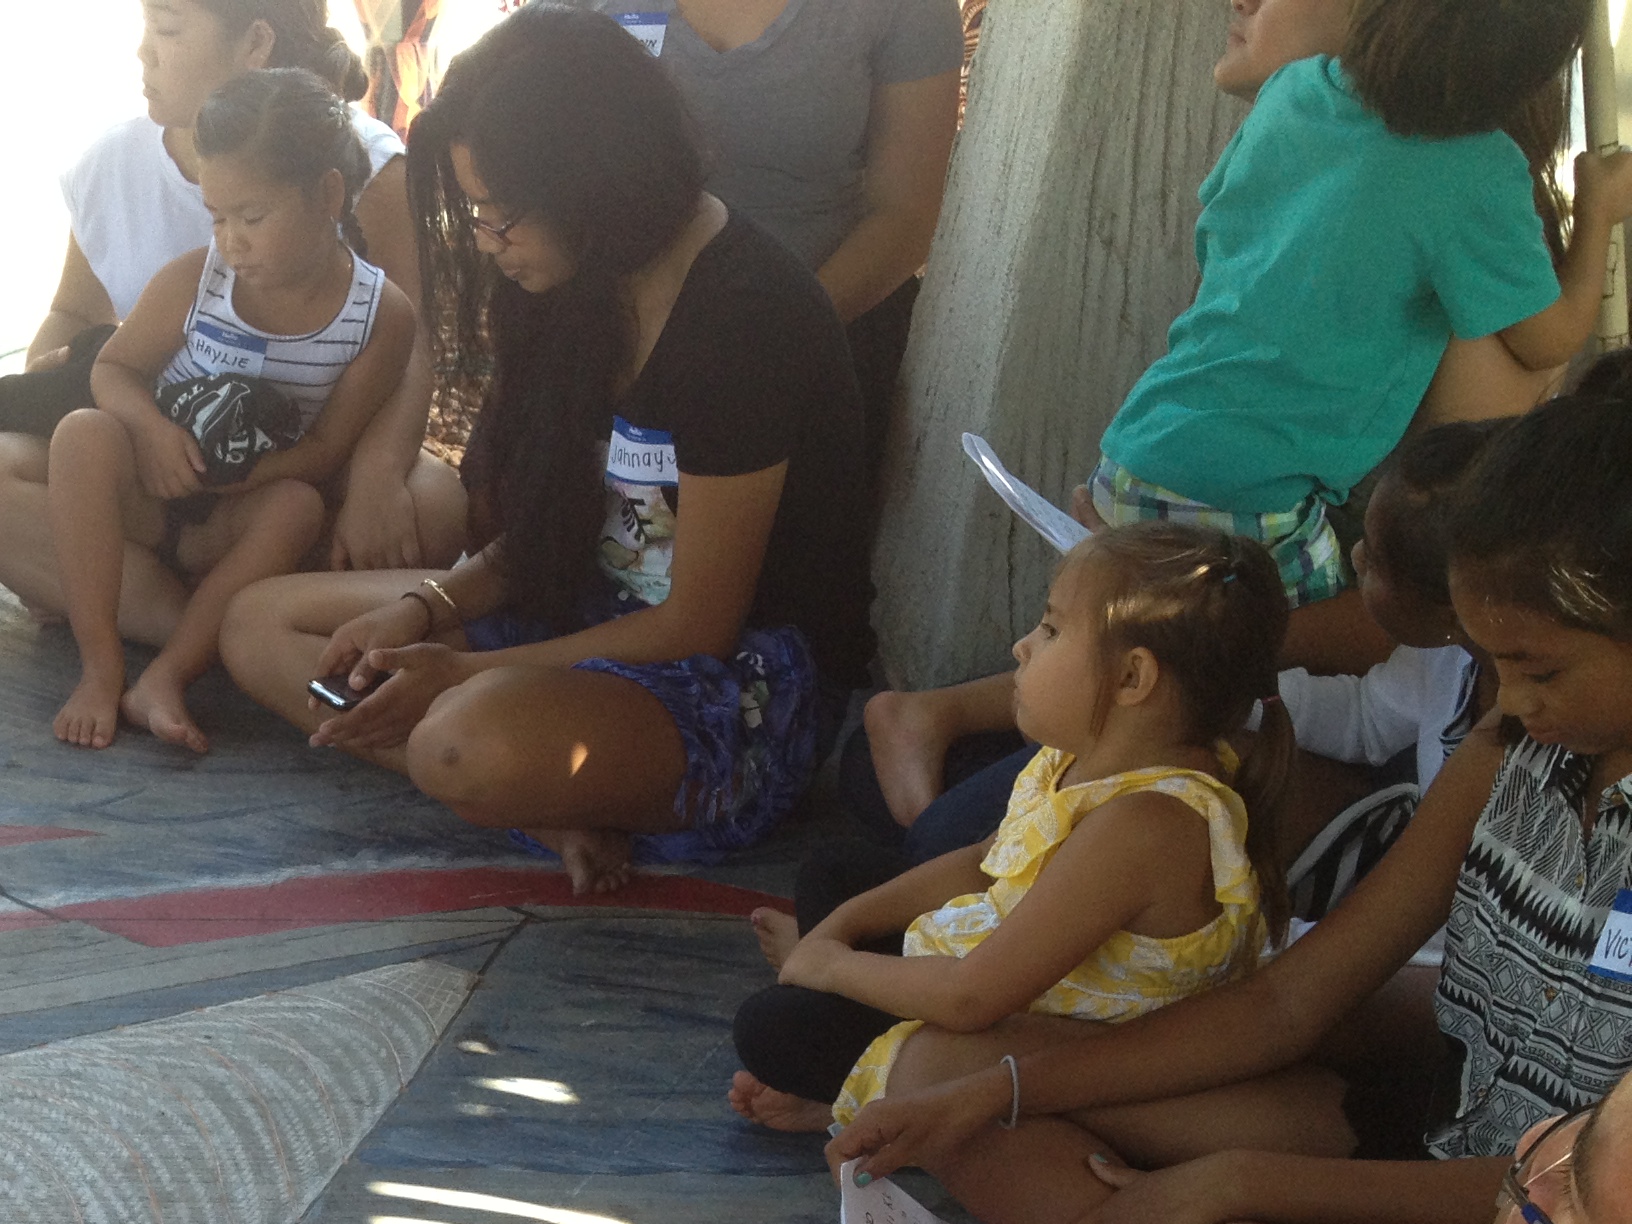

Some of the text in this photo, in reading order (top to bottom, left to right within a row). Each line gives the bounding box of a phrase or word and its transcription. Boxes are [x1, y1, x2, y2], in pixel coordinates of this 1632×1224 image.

[196, 339, 250, 368] HAYLIE
[612, 445, 663, 472] Jahnay
[1605, 929, 1632, 959] VIC
